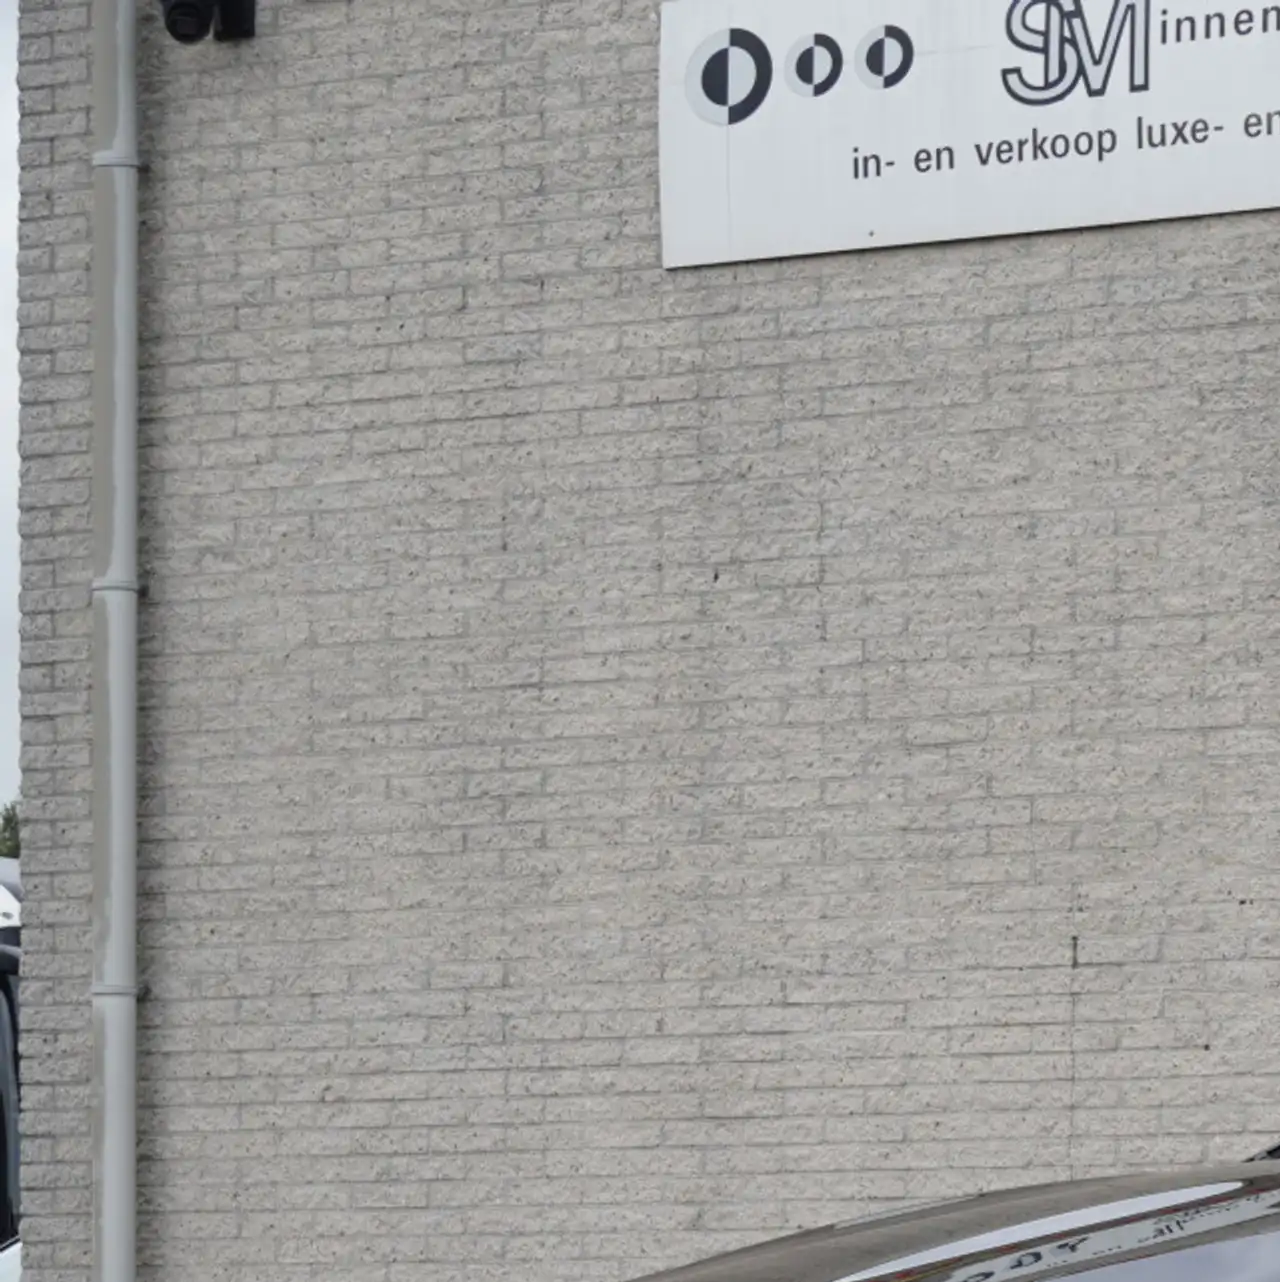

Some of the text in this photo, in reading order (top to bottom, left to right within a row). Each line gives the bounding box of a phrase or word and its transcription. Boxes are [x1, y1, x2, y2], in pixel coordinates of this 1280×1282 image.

[852, 147, 896, 179] in-
[914, 145, 955, 173] en
[974, 127, 1118, 162] verkoop
[1136, 115, 1225, 149] luxe-
